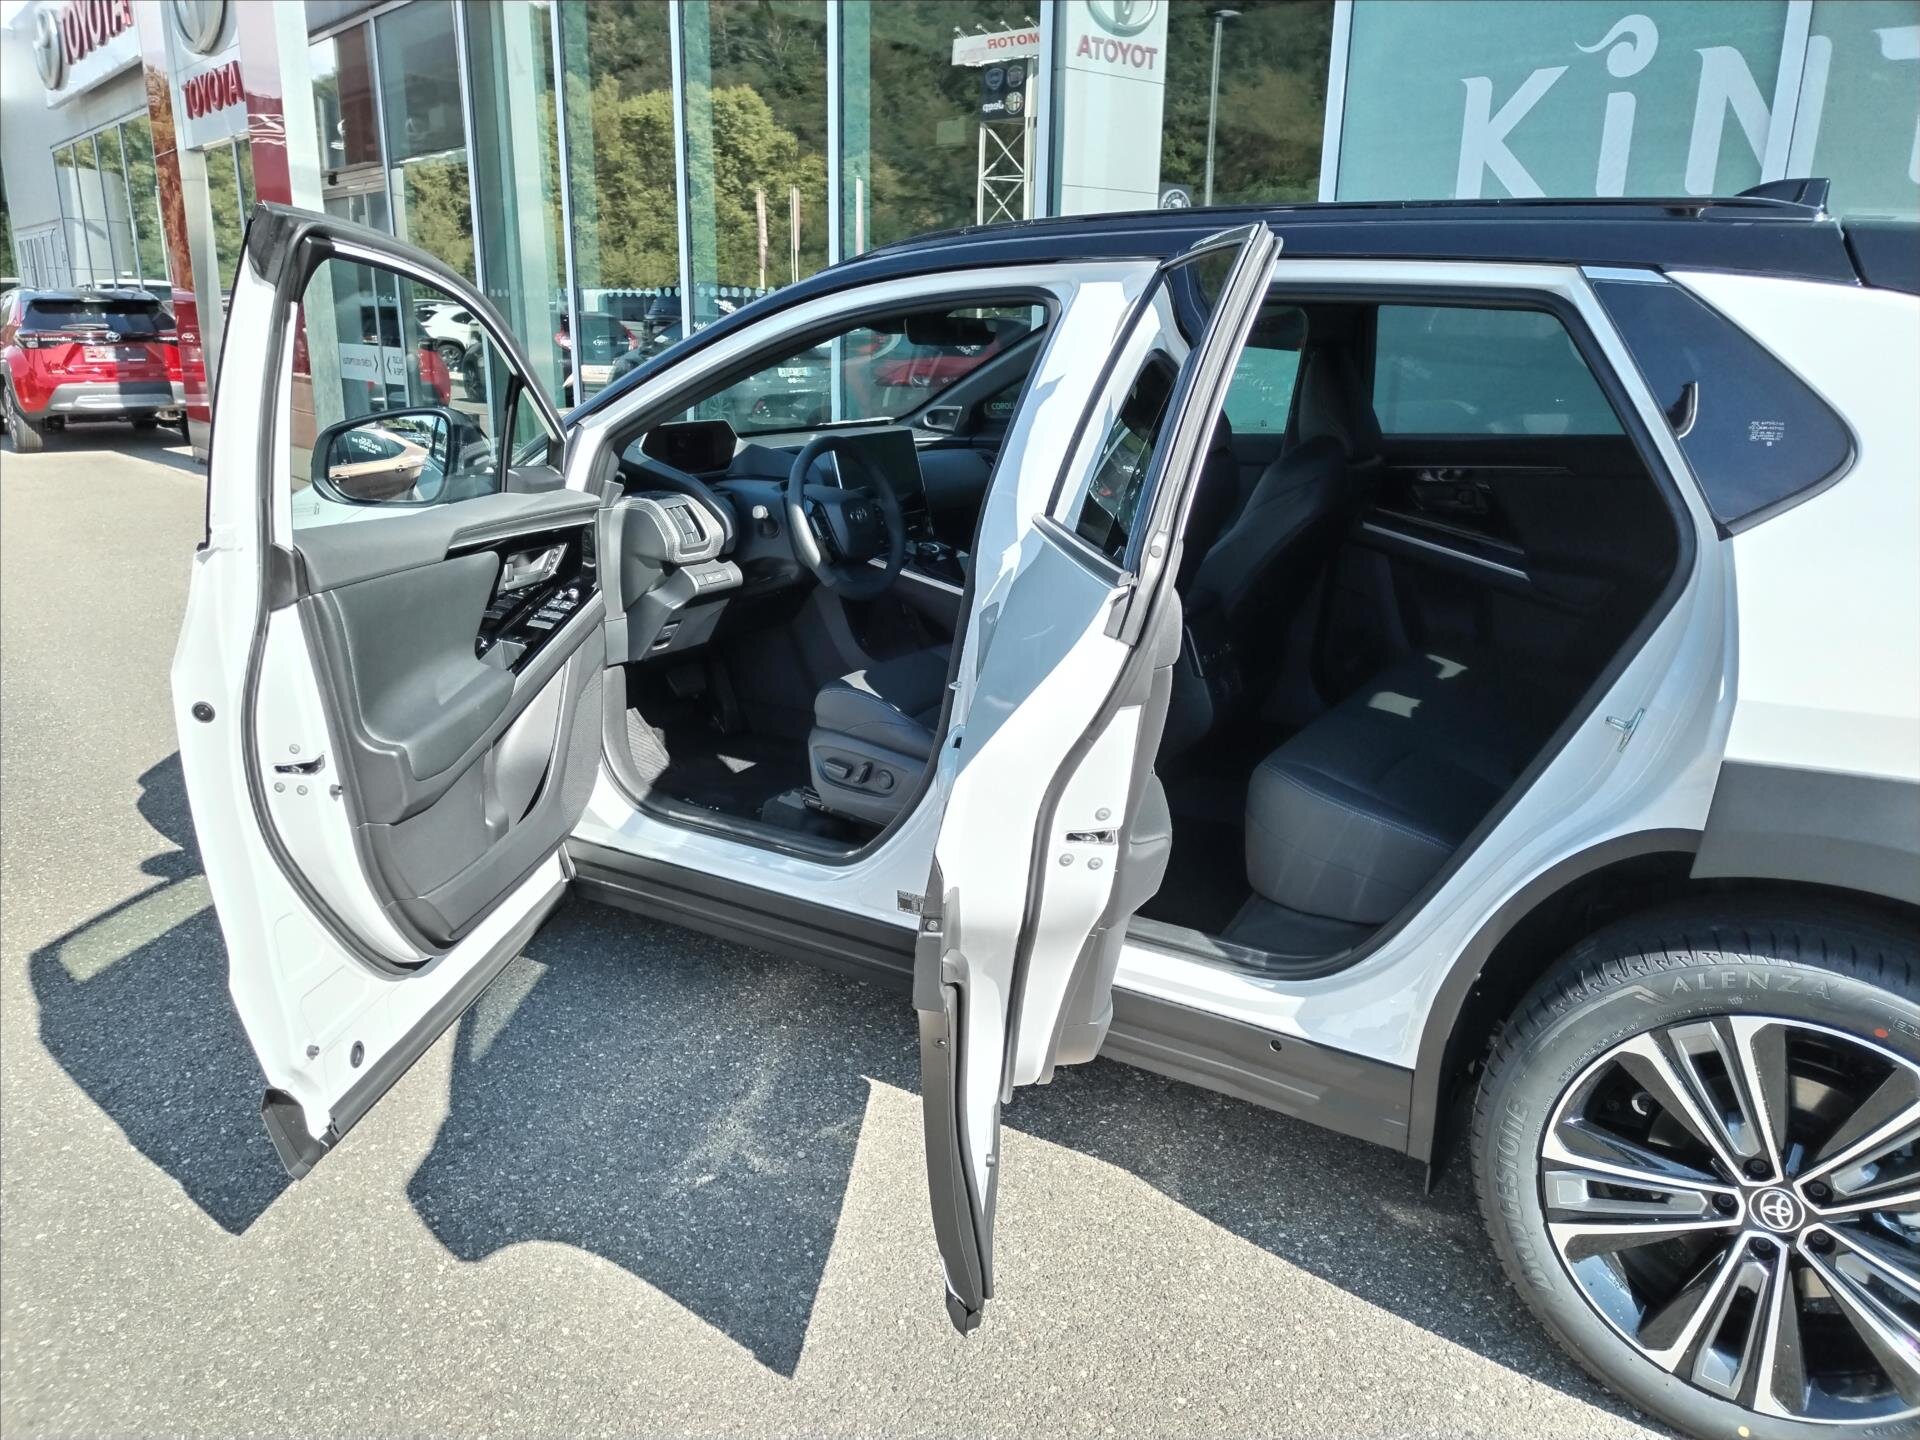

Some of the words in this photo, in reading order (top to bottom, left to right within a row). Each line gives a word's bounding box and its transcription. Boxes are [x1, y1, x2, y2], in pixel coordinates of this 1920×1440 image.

[57, 0, 136, 66] TOYOTA
[181, 60, 245, 120] TOYOTA
[1671, 970, 1840, 1000] ALENZA
